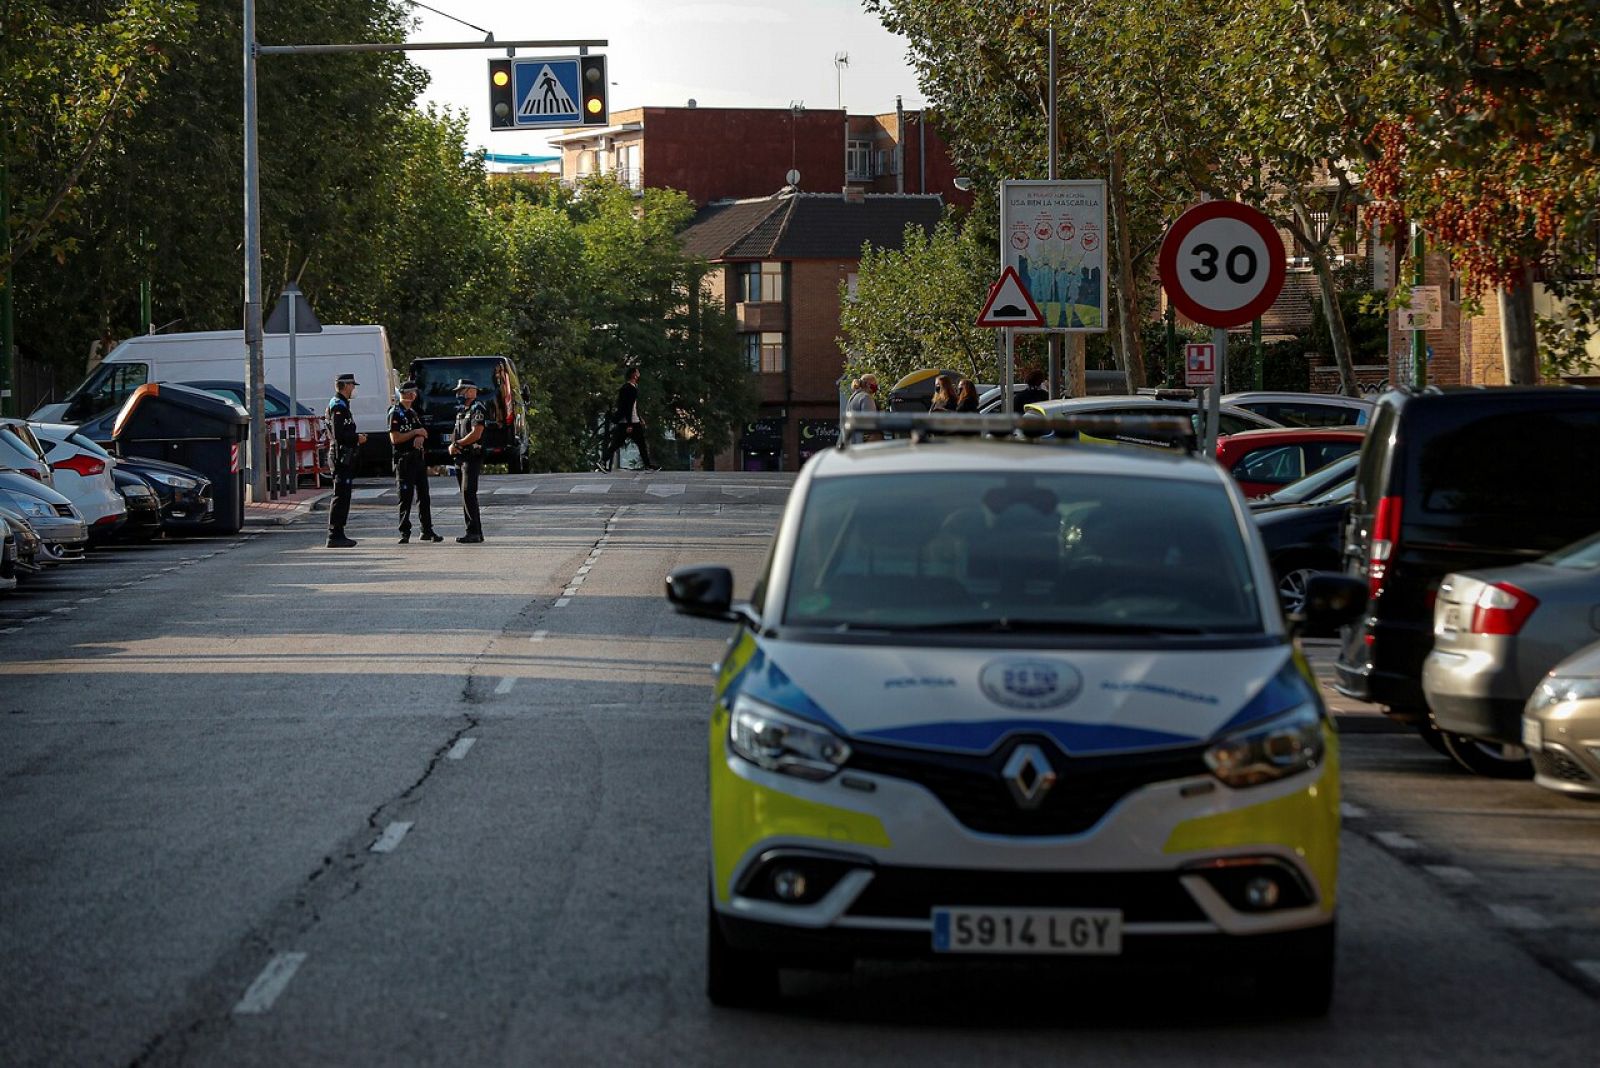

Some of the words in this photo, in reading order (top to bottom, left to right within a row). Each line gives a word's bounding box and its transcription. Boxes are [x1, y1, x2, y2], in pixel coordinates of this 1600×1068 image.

[1189, 243, 1257, 284] 30
[1190, 348, 1211, 369] H
[956, 913, 1036, 945] 5914
[1048, 915, 1110, 947] LGY
